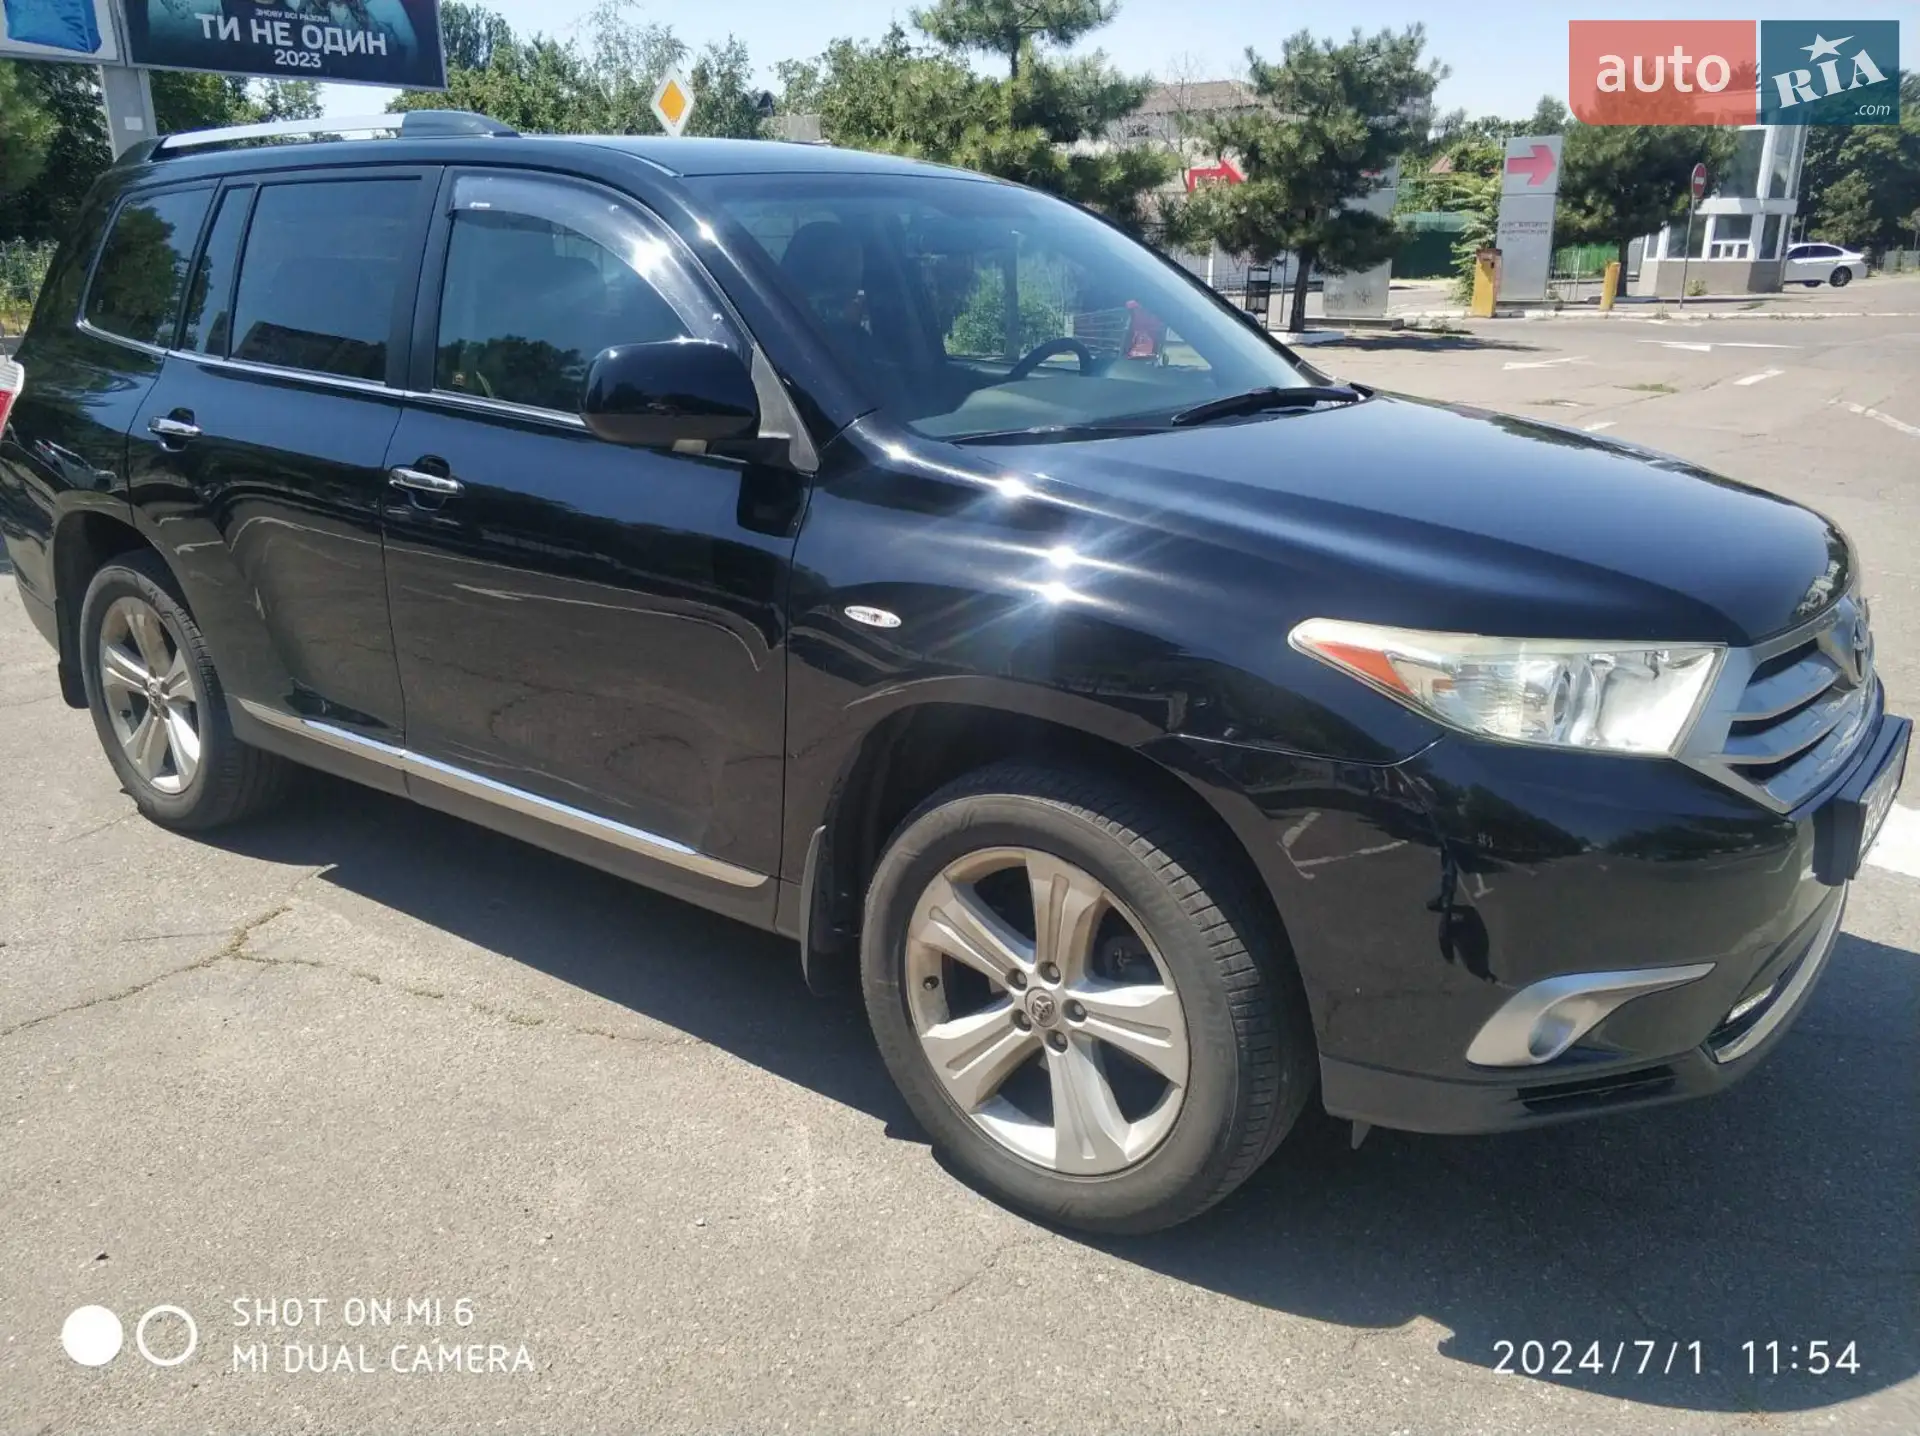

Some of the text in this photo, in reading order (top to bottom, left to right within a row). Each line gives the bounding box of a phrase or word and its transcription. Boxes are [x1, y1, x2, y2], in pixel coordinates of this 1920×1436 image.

[195, 12, 388, 56] ТИ НЕ ОДИН
[274, 49, 322, 68] 2023
